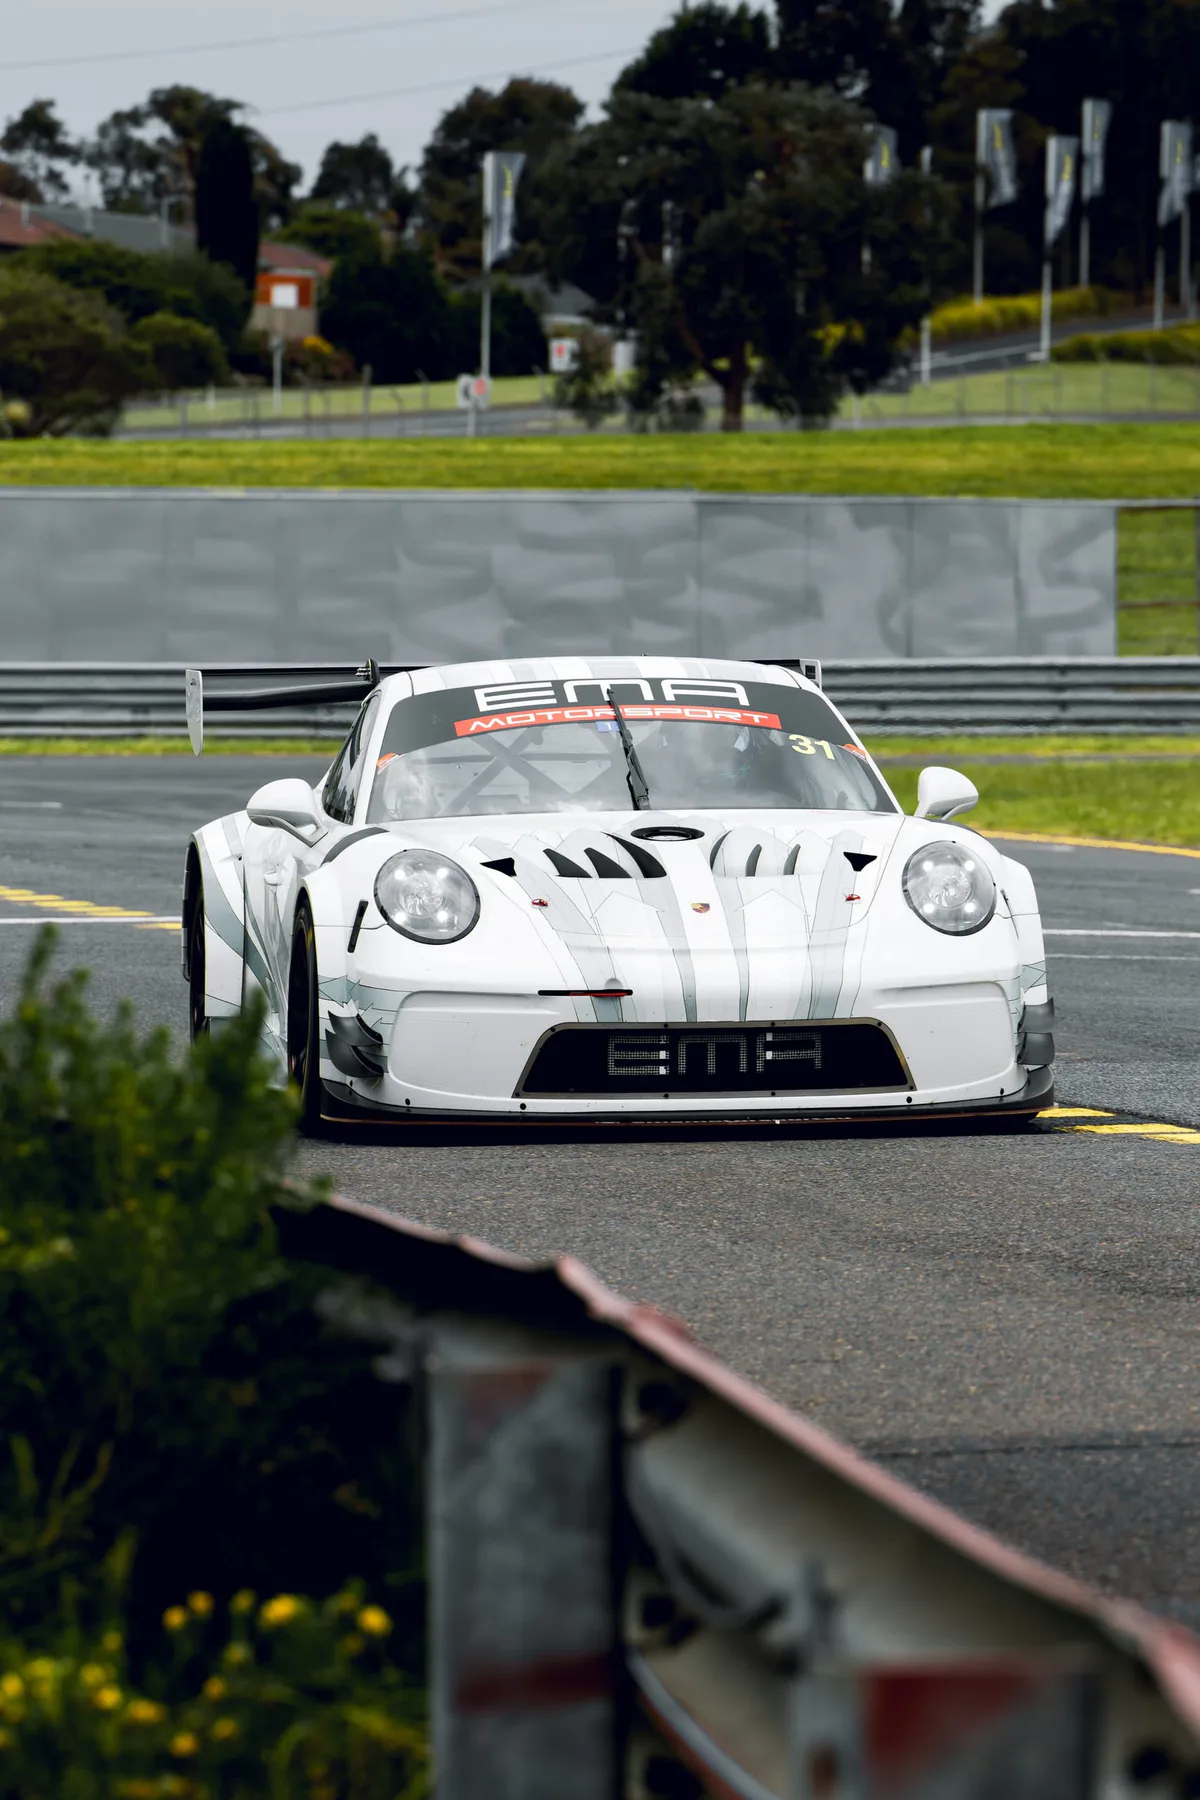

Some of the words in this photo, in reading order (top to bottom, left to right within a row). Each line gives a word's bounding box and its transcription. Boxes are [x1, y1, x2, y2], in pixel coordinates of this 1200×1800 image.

[474, 679, 750, 712] EMA
[469, 708, 768, 732] MOTORSPORT
[788, 734, 835, 760] 31
[608, 1032, 822, 1075] EMA
